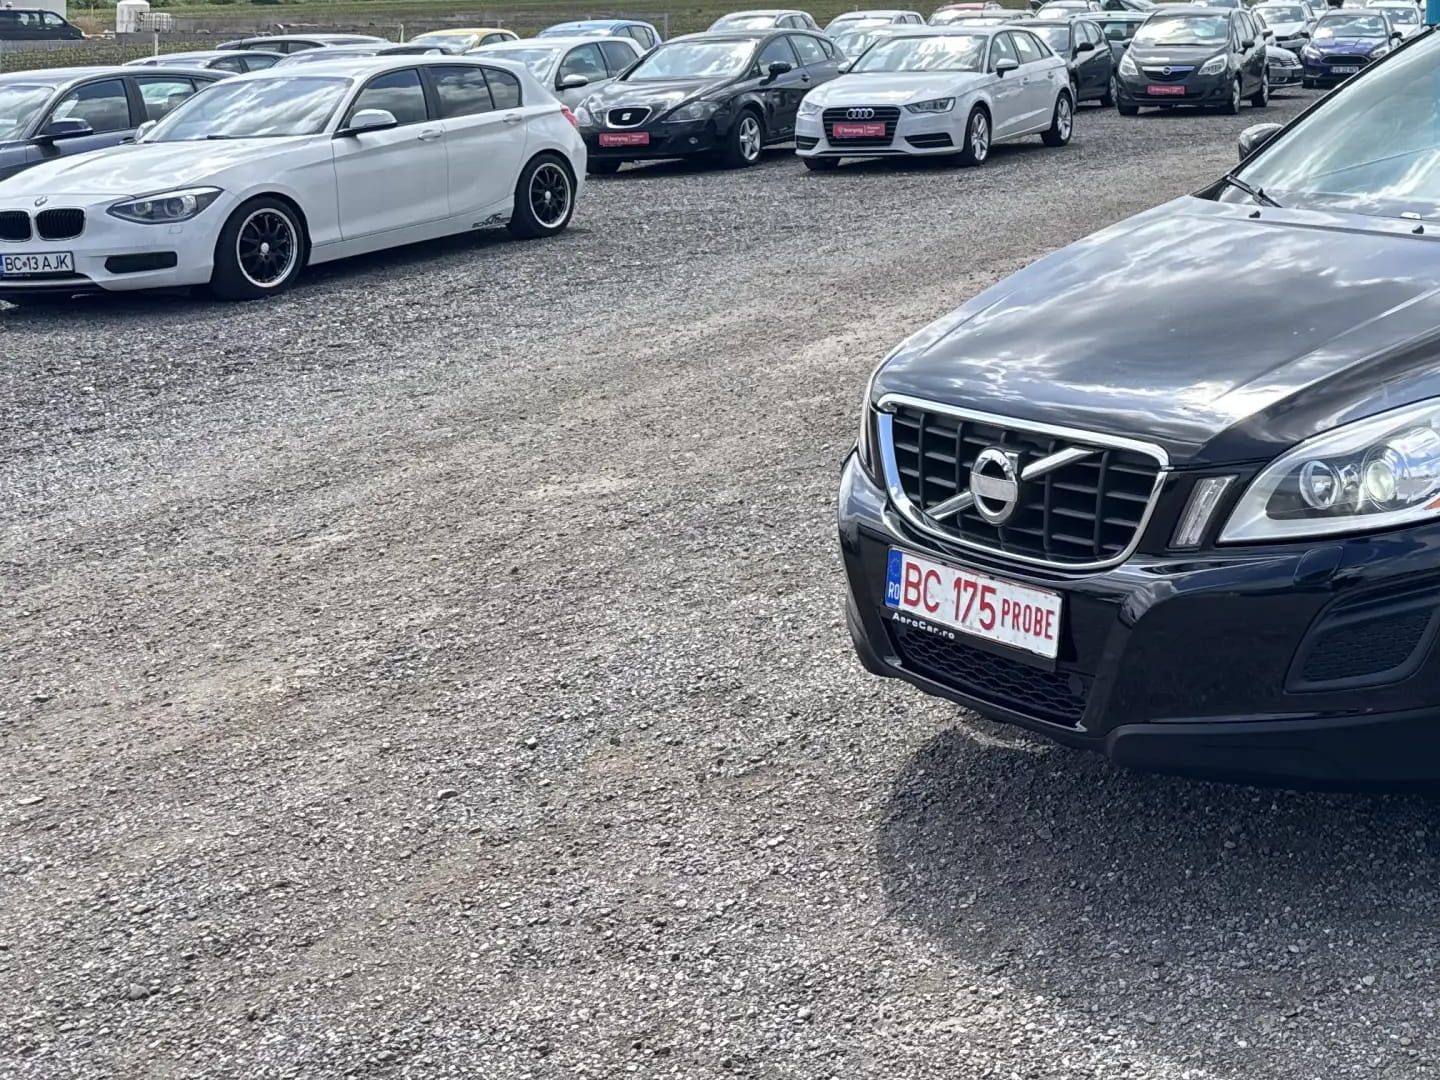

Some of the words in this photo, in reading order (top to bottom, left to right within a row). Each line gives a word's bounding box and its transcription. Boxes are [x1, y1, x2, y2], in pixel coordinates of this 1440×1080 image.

[4, 256, 22, 271] BC
[27, 256, 39, 270] 13
[42, 254, 69, 270] AJK
[888, 581, 900, 600] RO
[904, 562, 941, 613] BC
[953, 576, 997, 631] 175
[1001, 598, 1055, 640] PROBE
[892, 612, 955, 640] AeroCar.ro
